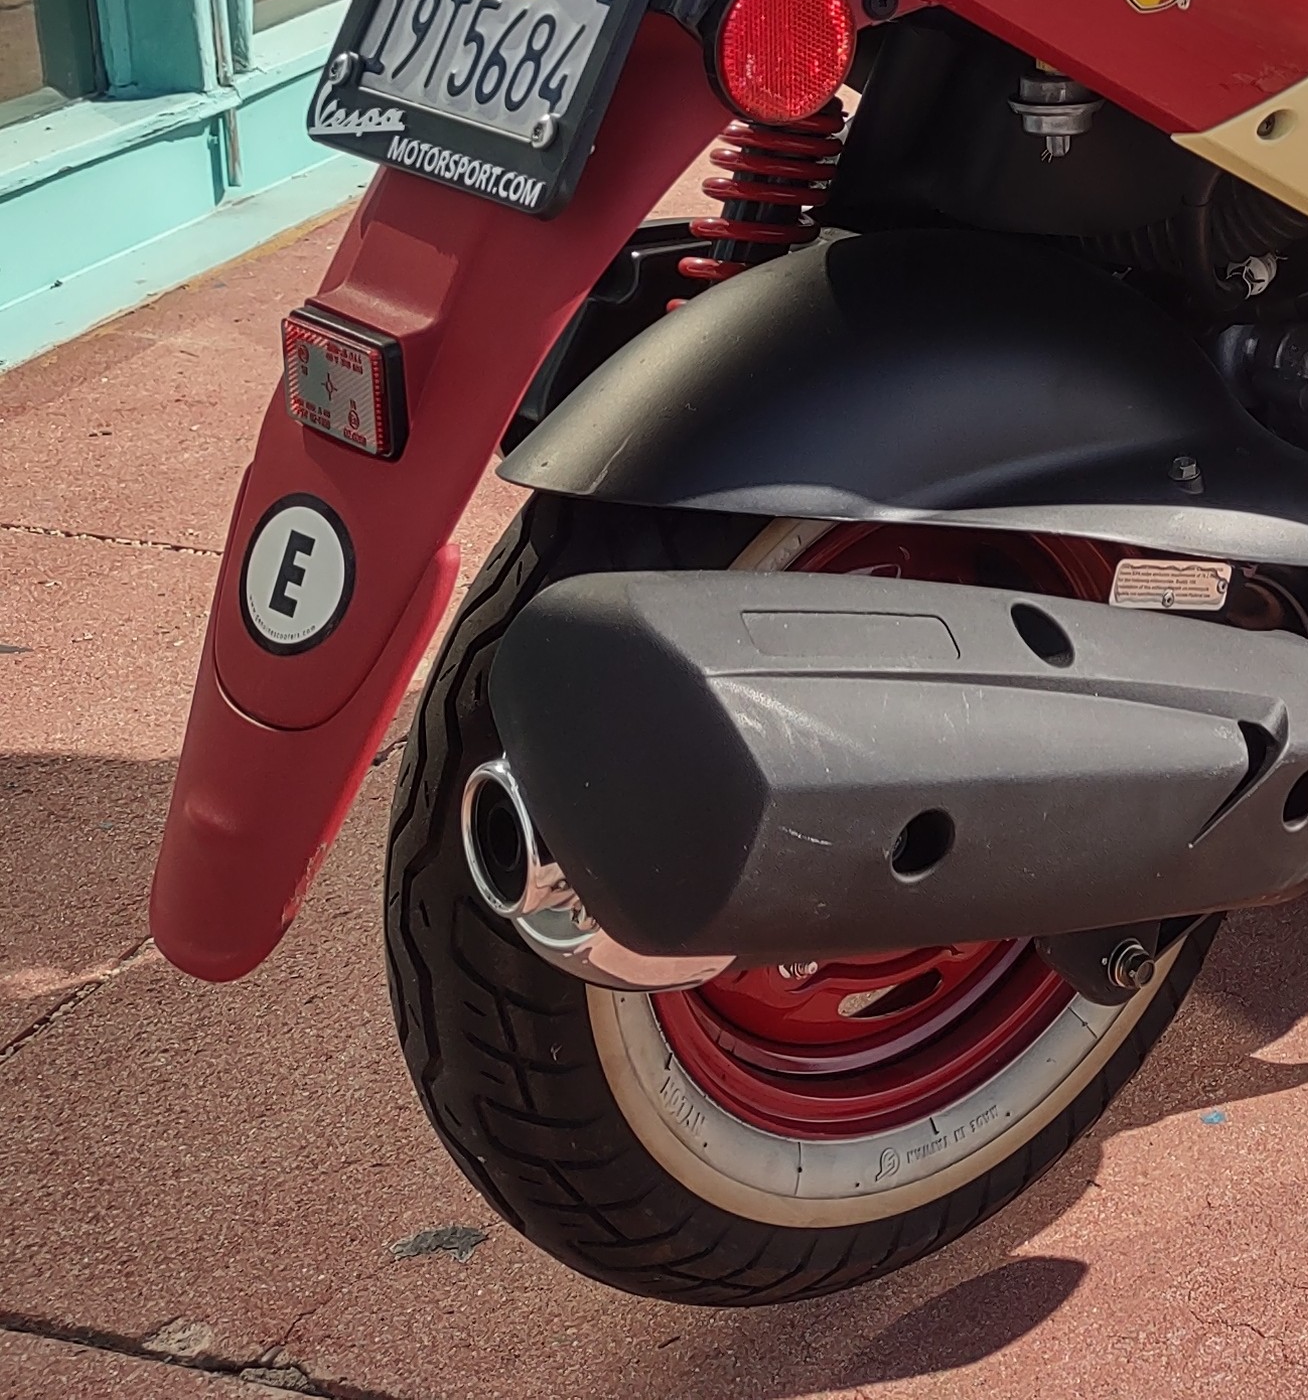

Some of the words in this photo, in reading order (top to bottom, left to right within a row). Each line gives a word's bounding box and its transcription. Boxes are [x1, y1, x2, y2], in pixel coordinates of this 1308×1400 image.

[308, 83, 406, 137] Vespa
[387, 135, 547, 208] MOTORSPORT.COM
[268, 529, 316, 619] E
[954, 1126, 966, 1142] IN
[969, 1104, 998, 1133] MADE
[906, 1135, 948, 1164] TAIWAN
